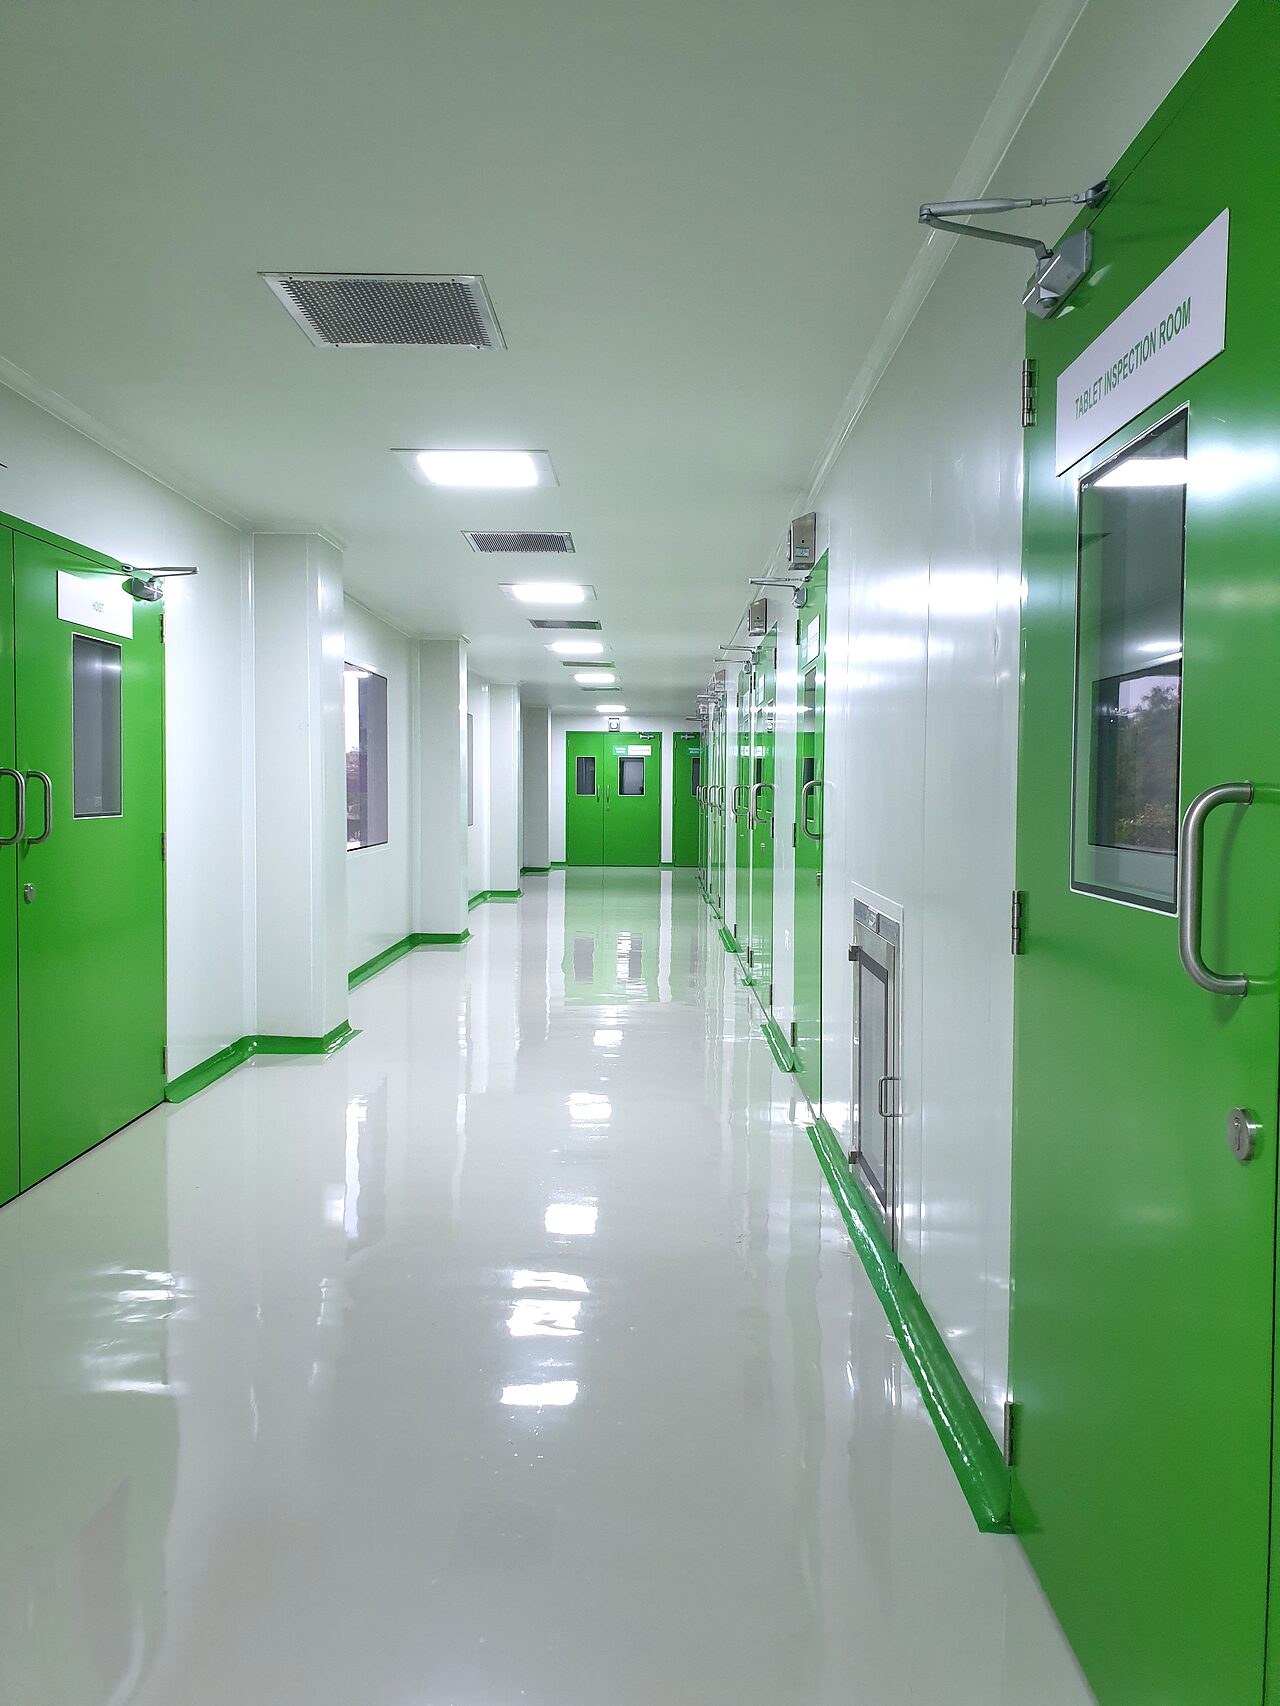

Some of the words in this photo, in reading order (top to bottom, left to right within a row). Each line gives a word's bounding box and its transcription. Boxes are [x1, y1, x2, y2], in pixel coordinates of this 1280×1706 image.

[1075, 376, 1103, 420] TABLET
[1104, 327, 1157, 396] INSPECTION
[1159, 296, 1191, 350] ROOM
